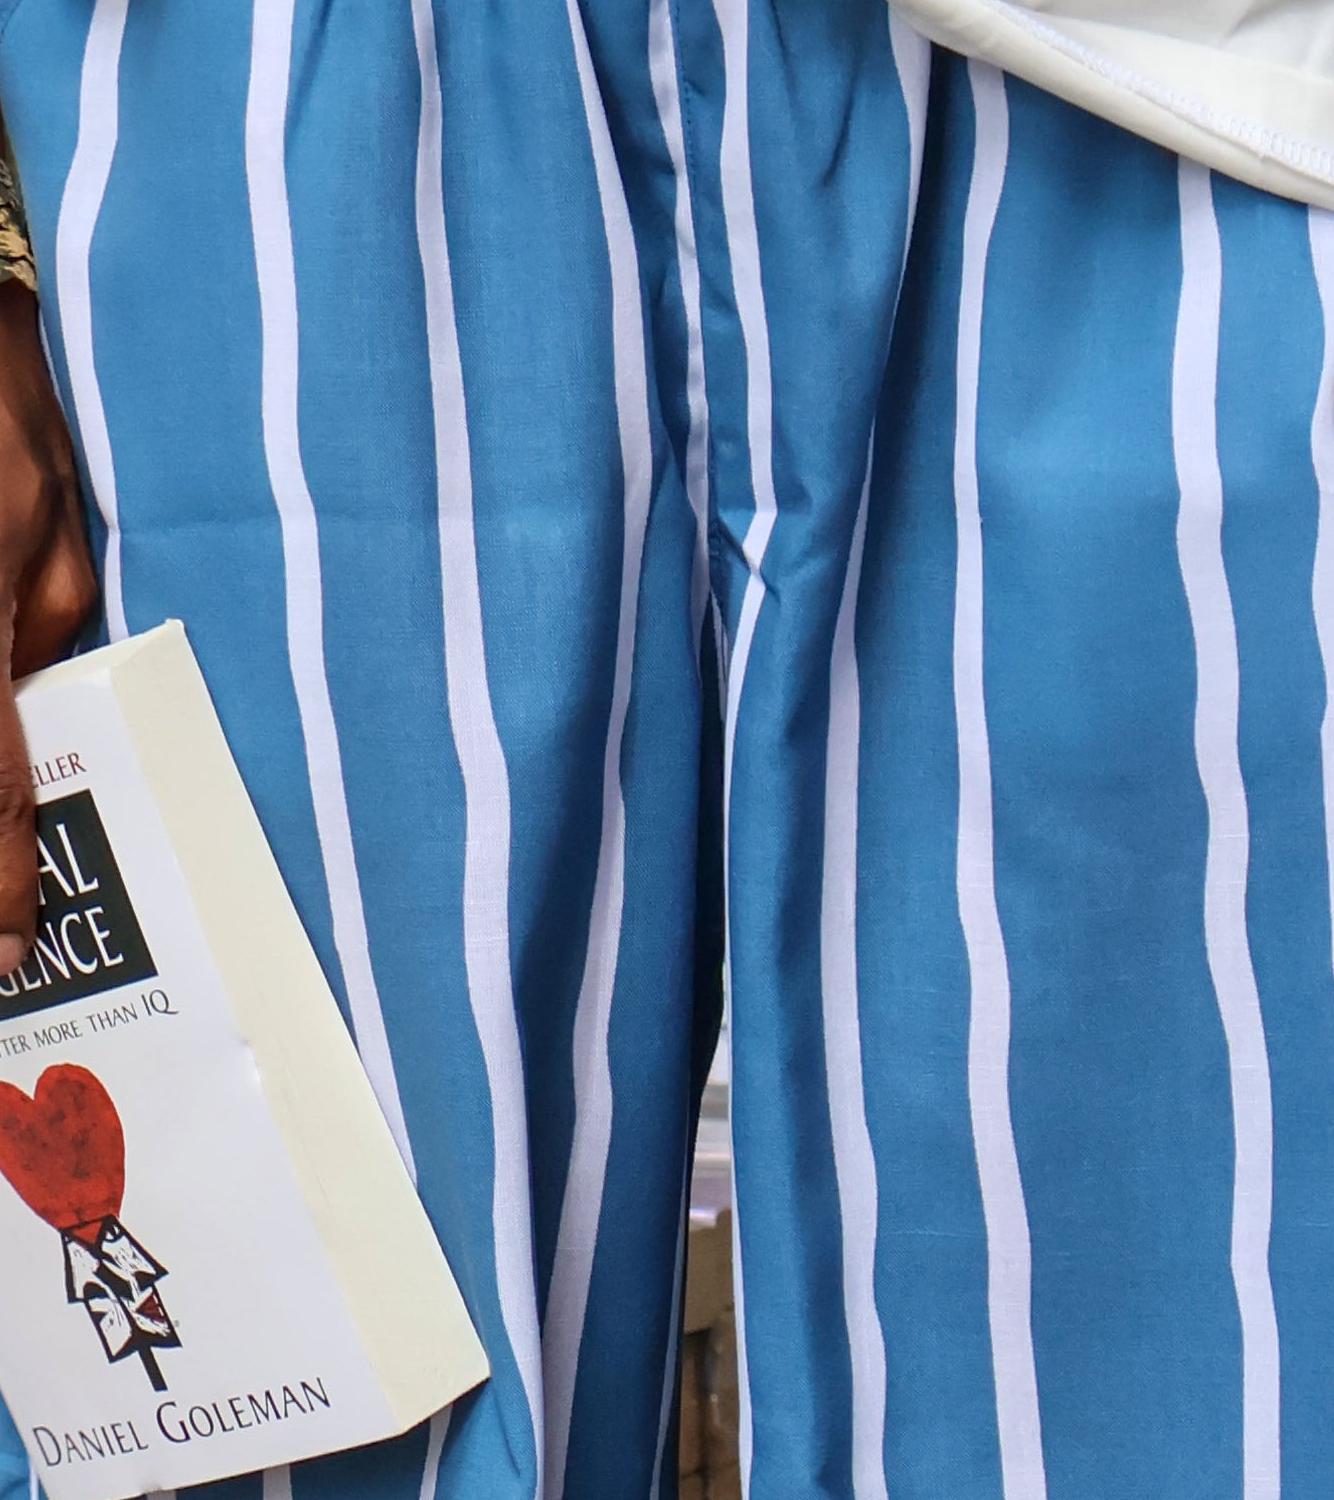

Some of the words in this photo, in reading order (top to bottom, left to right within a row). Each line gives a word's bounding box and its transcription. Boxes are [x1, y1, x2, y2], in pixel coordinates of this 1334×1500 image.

[33, 1019, 83, 1048] MORE
[86, 1006, 139, 1033] THAN
[142, 988, 179, 1019] IQ
[32, 1421, 148, 1468] DANIEL
[156, 1376, 331, 1444] GOLEMAN
